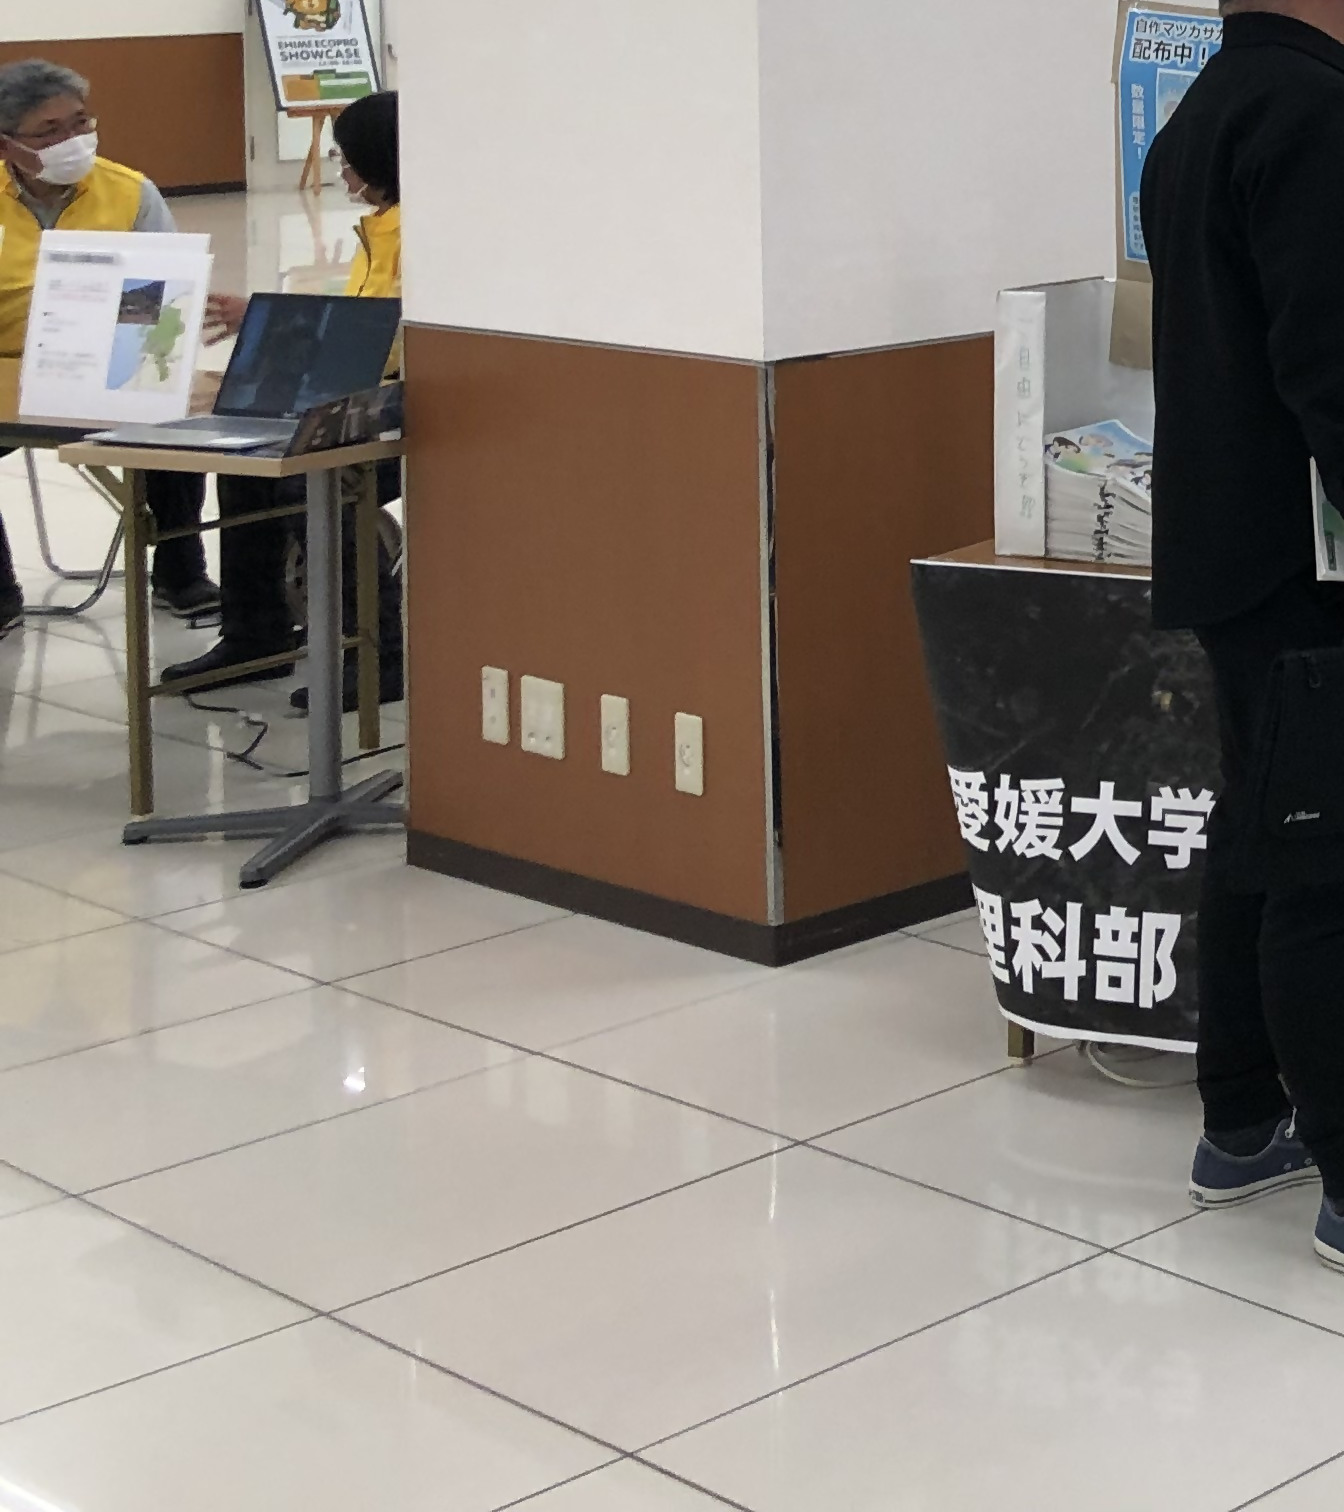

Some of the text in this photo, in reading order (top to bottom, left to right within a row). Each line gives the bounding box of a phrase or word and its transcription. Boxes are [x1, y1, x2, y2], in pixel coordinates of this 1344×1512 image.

[280, 48, 361, 61] SHOWCASE
[1132, 37, 1207, 66] 配布中!
